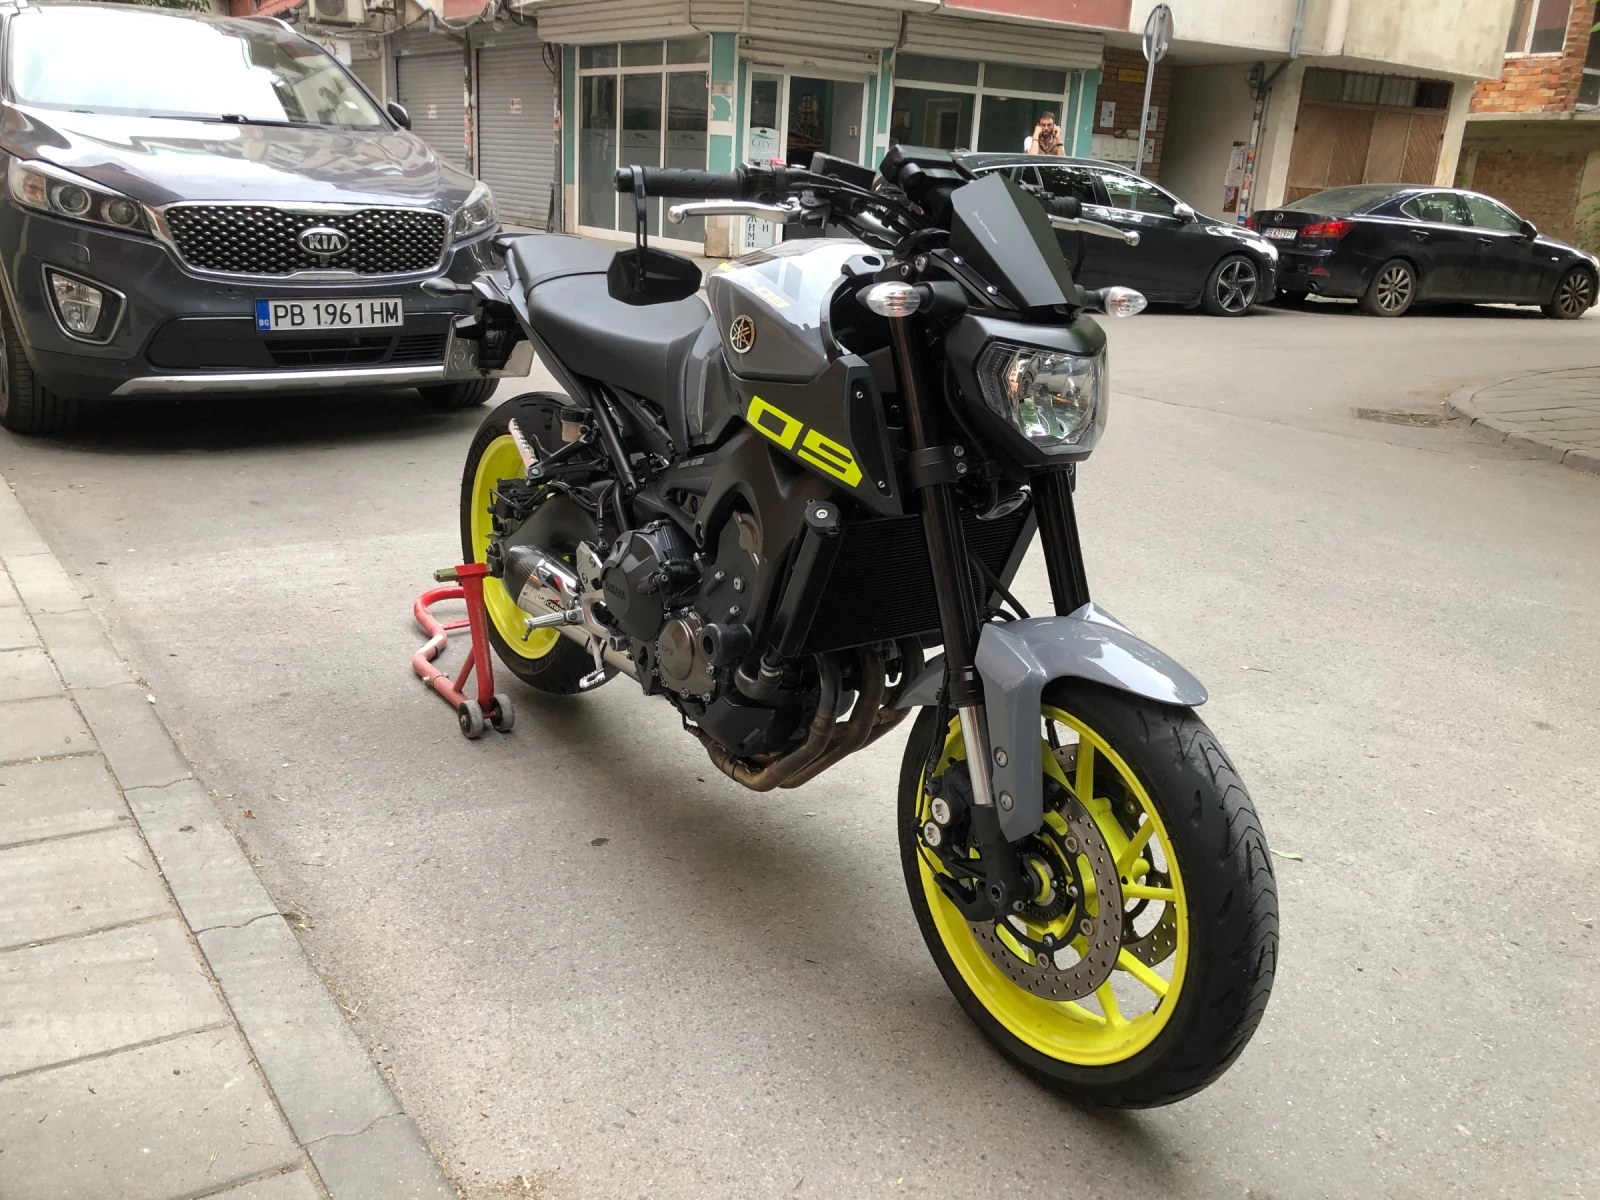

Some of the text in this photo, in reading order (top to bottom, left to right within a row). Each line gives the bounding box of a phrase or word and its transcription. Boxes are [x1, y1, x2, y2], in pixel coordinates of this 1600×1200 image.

[751, 138, 772, 148] CITY
[308, 235, 342, 249] KIA
[273, 301, 399, 327] PB 1961 HM
[258, 318, 270, 327] BG
